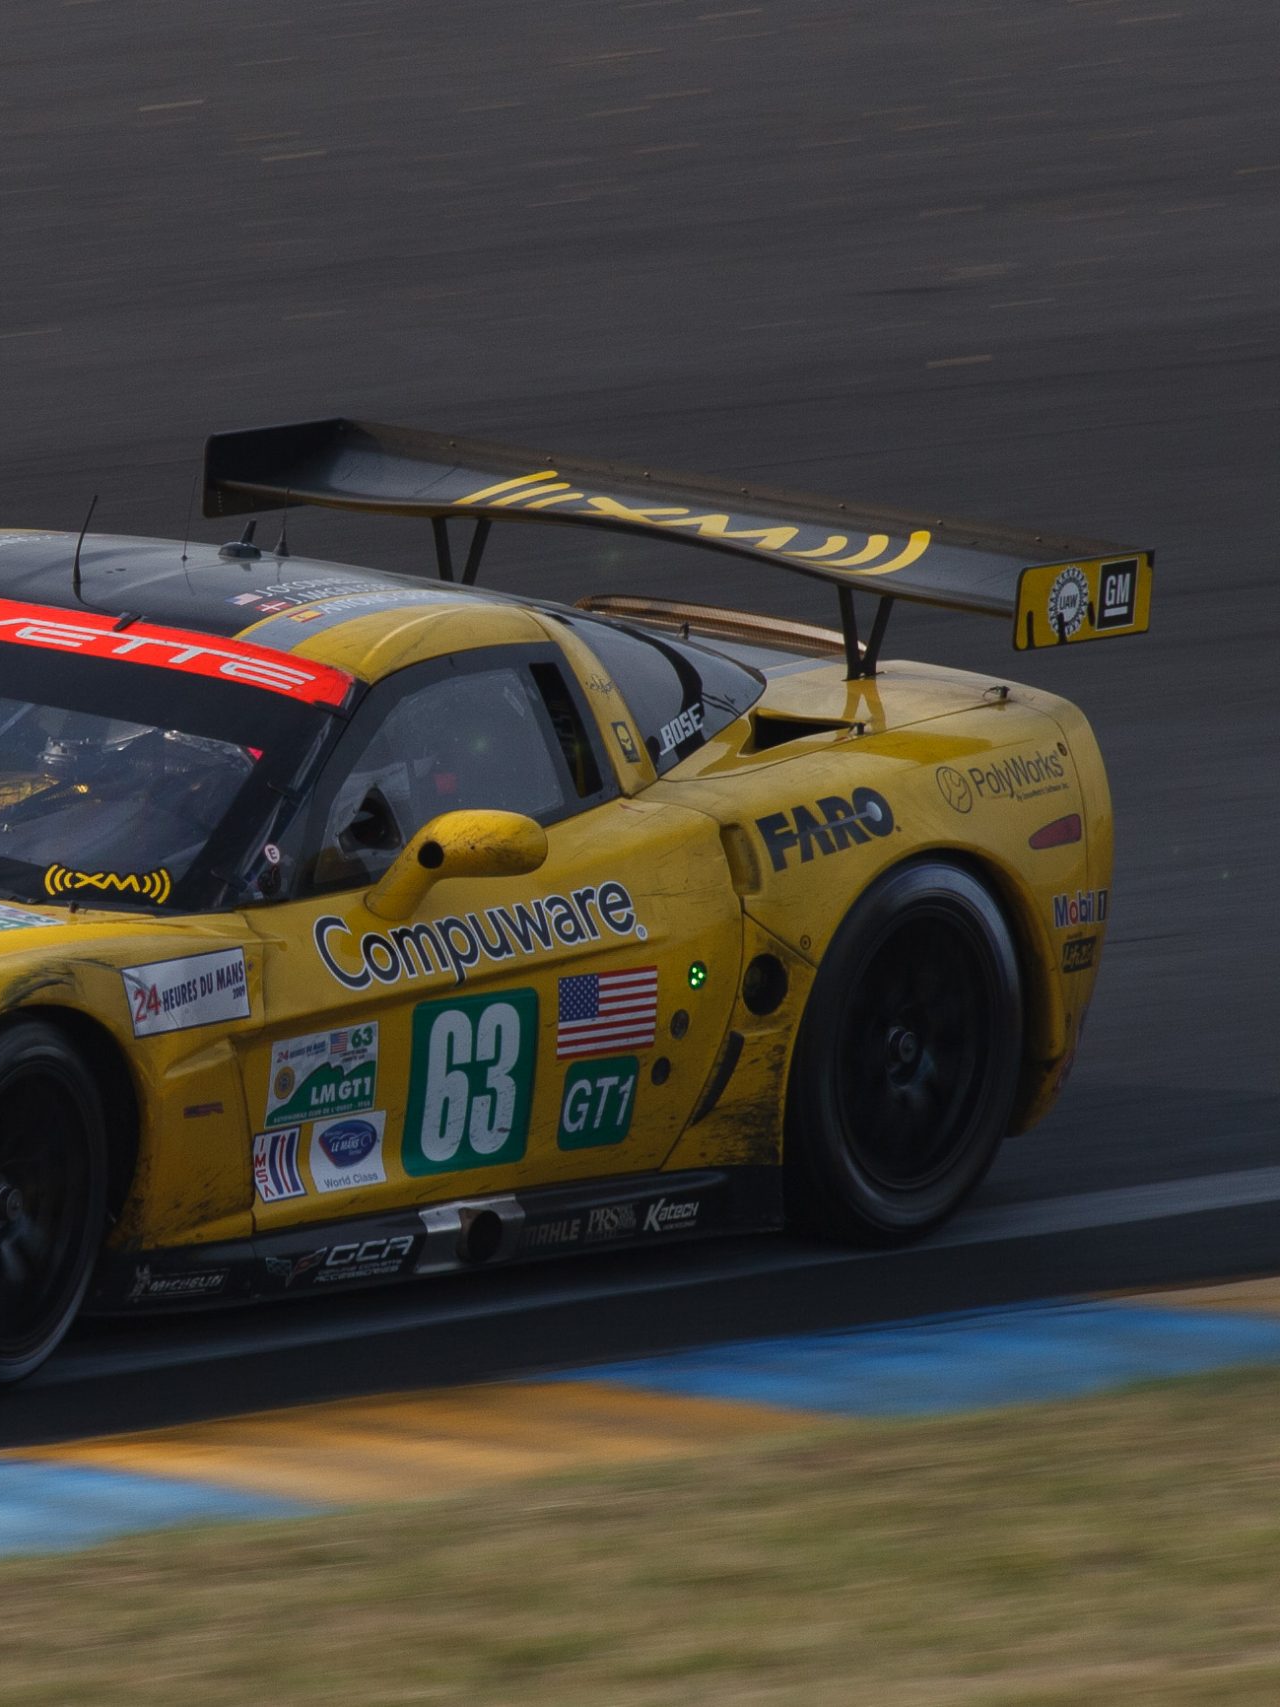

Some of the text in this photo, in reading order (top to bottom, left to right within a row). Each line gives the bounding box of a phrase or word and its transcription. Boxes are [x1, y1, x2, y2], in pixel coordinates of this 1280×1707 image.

[1059, 593, 1078, 610] UAW
[1105, 573, 1131, 606] GM
[659, 702, 704, 756] BOSE
[968, 751, 1064, 798] PolyWorks
[755, 786, 895, 872] FARO
[313, 880, 637, 988] Compuware
[1053, 890, 1094, 929] Mobil
[133, 960, 244, 1023] 24 HEURES DU MANS
[351, 1025, 373, 1048] 63
[420, 1002, 520, 1162] 63
[562, 1073, 635, 1134] GT1
[255, 1138, 275, 1198] IMSA
[323, 1172, 378, 1189] World Class
